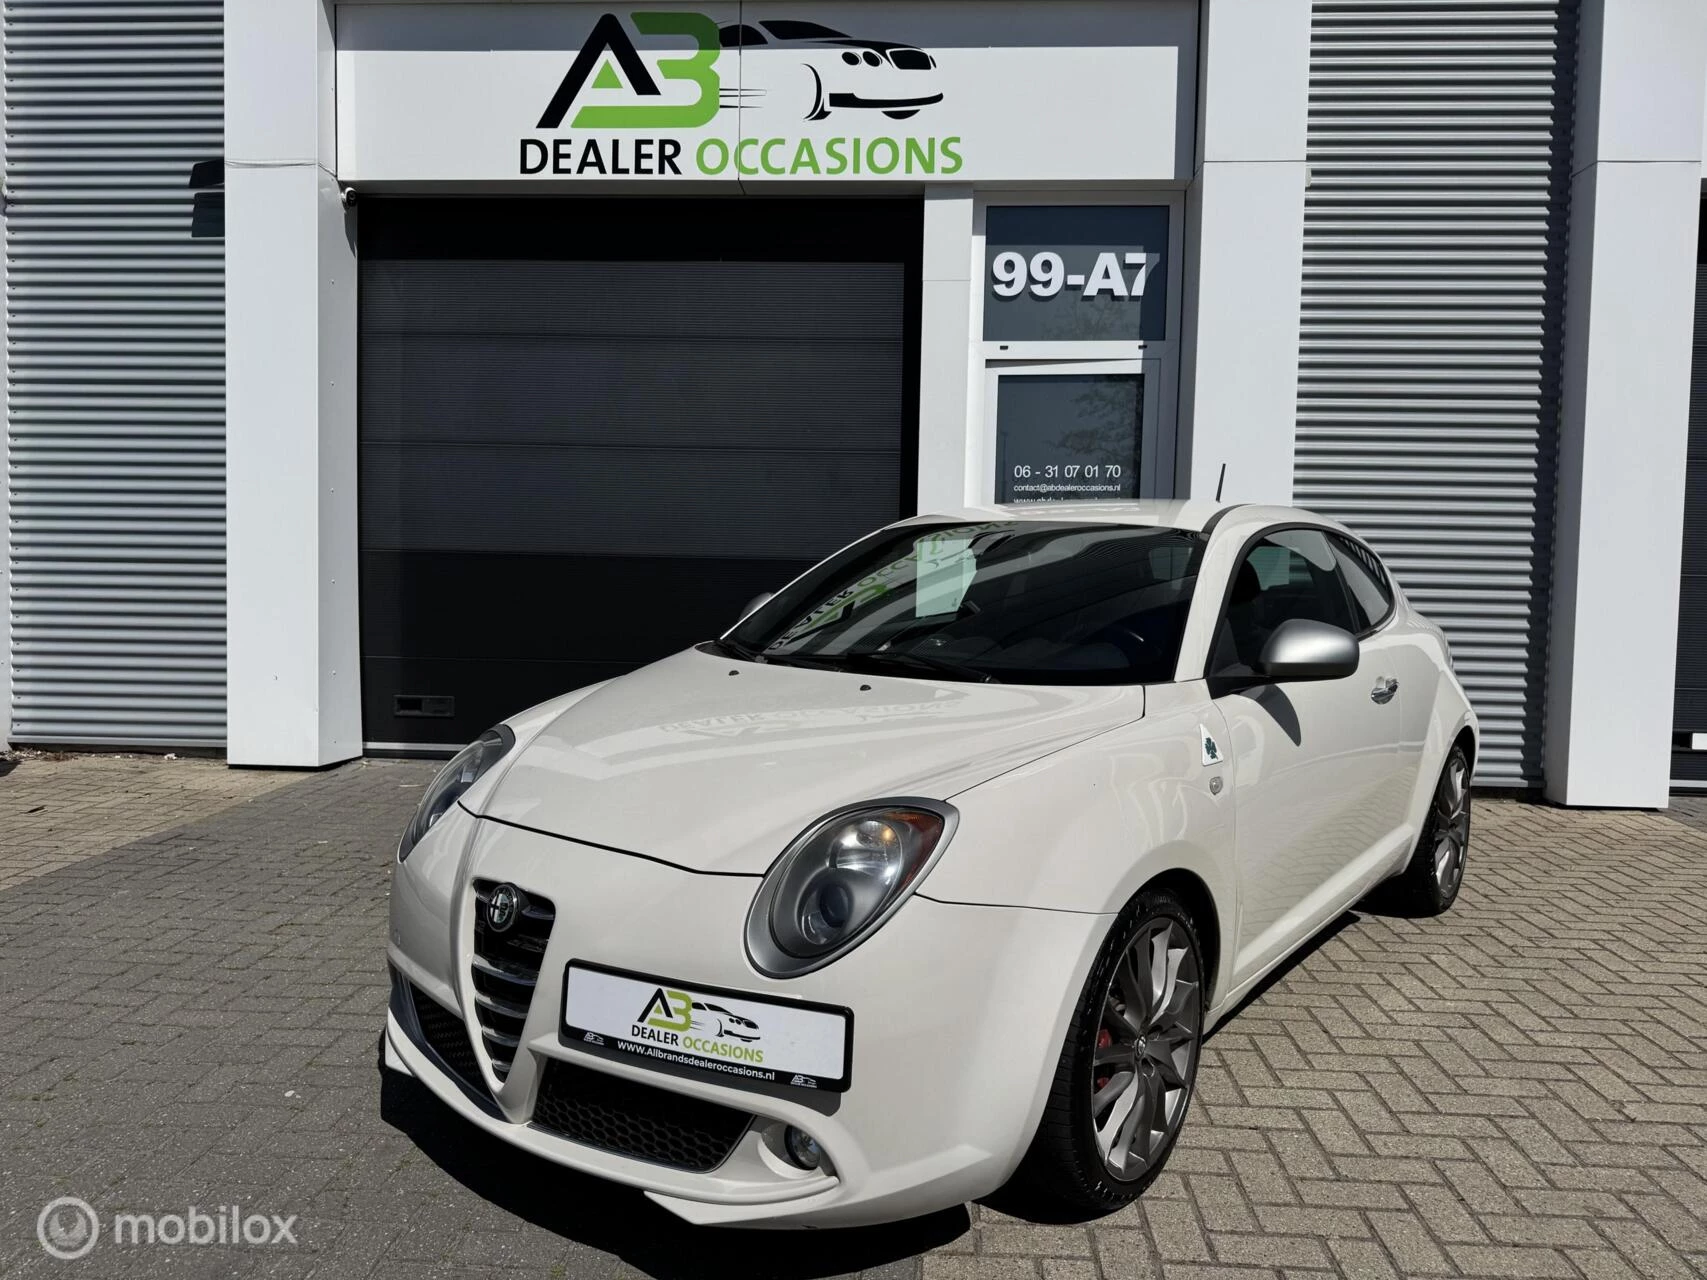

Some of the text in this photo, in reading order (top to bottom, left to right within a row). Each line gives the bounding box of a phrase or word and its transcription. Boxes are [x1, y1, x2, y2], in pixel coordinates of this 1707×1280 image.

[519, 136, 963, 176] DEALER OCCASIONS
[992, 251, 1160, 297] 99-A7
[1013, 484, 1121, 493] contact@abdealeroccasions.nl
[1014, 465, 1031, 478] 06
[1045, 465, 1059, 478] 31
[1064, 465, 1080, 478] 07
[1084, 465, 1099, 478] 01
[1105, 465, 1121, 478] 70
[631, 1024, 764, 1063] DEALER OCCASIONS
